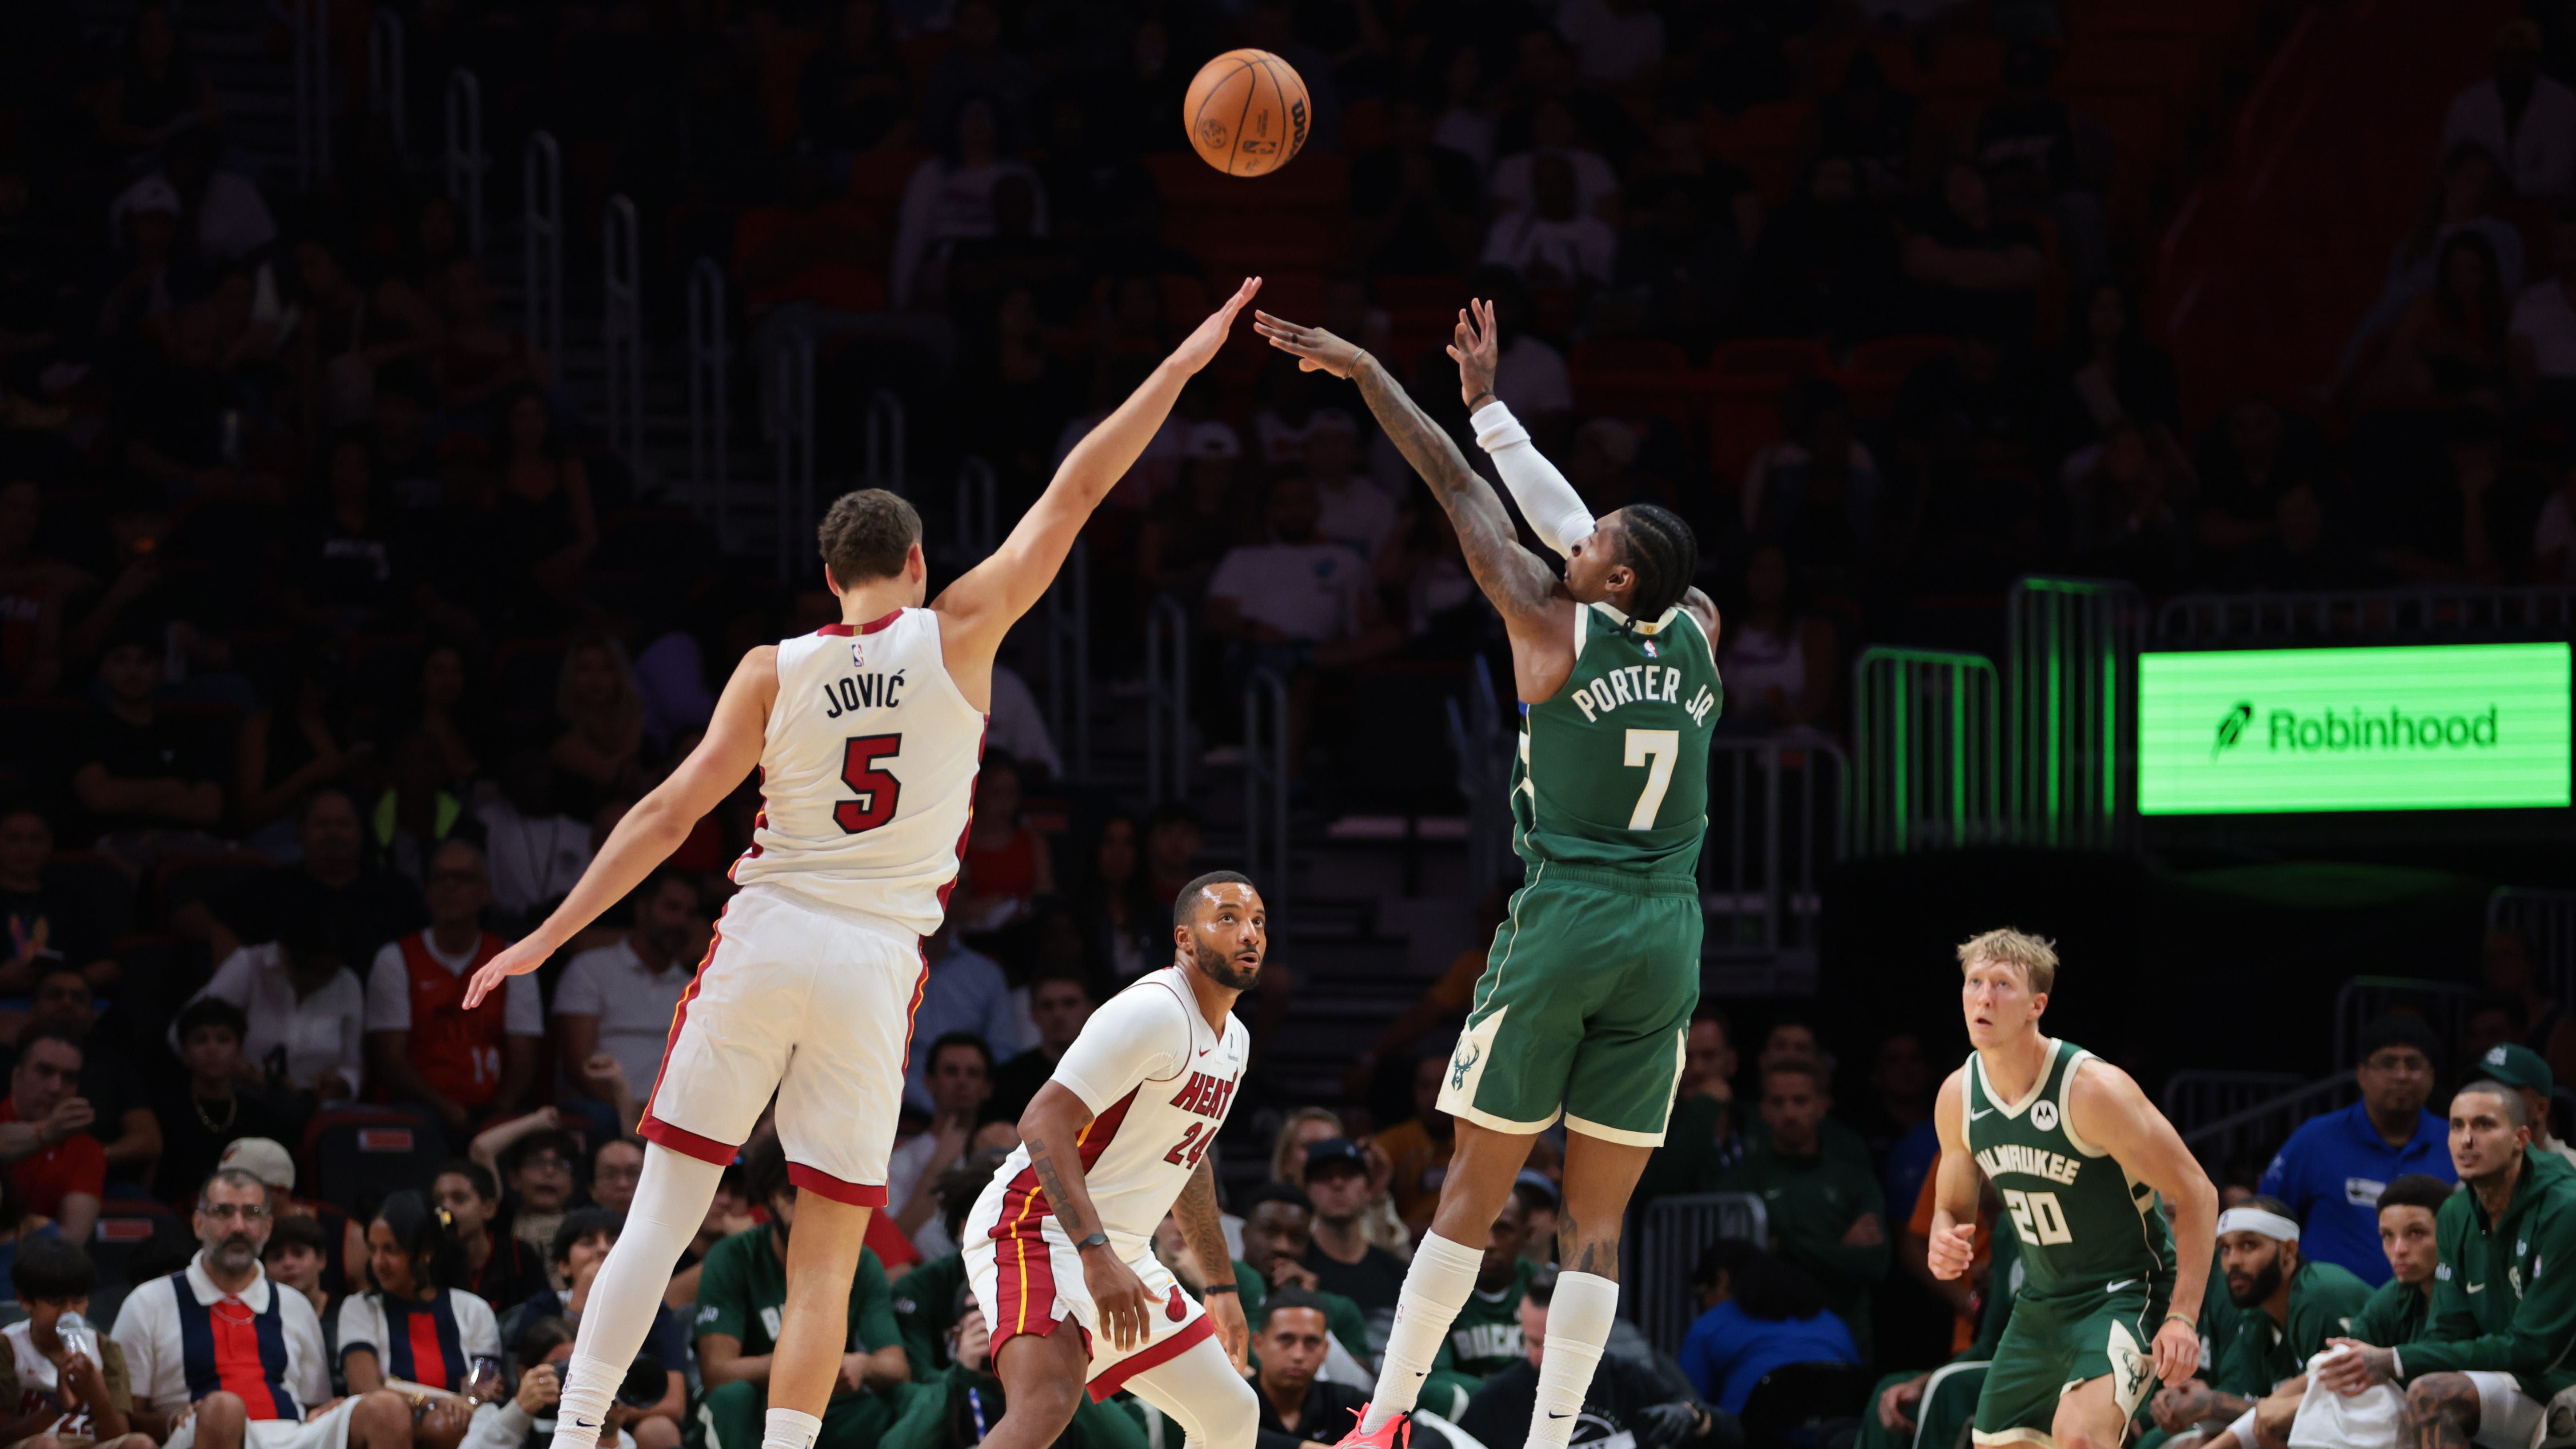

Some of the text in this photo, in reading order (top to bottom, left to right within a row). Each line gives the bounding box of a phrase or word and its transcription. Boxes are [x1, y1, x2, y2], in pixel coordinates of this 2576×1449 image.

[824, 669, 906, 718] JOVIĆ
[1572, 665, 1715, 727] PORTER JR
[2269, 705, 2496, 749] Robinhood
[833, 732, 902, 834] 5
[1624, 729, 1679, 830] 7
[1169, 1066, 1238, 1120] HEAT
[1163, 1122, 1217, 1170] 24
[2003, 1189, 2073, 1247] 20
[1452, 1323, 1529, 1361] BUCK
